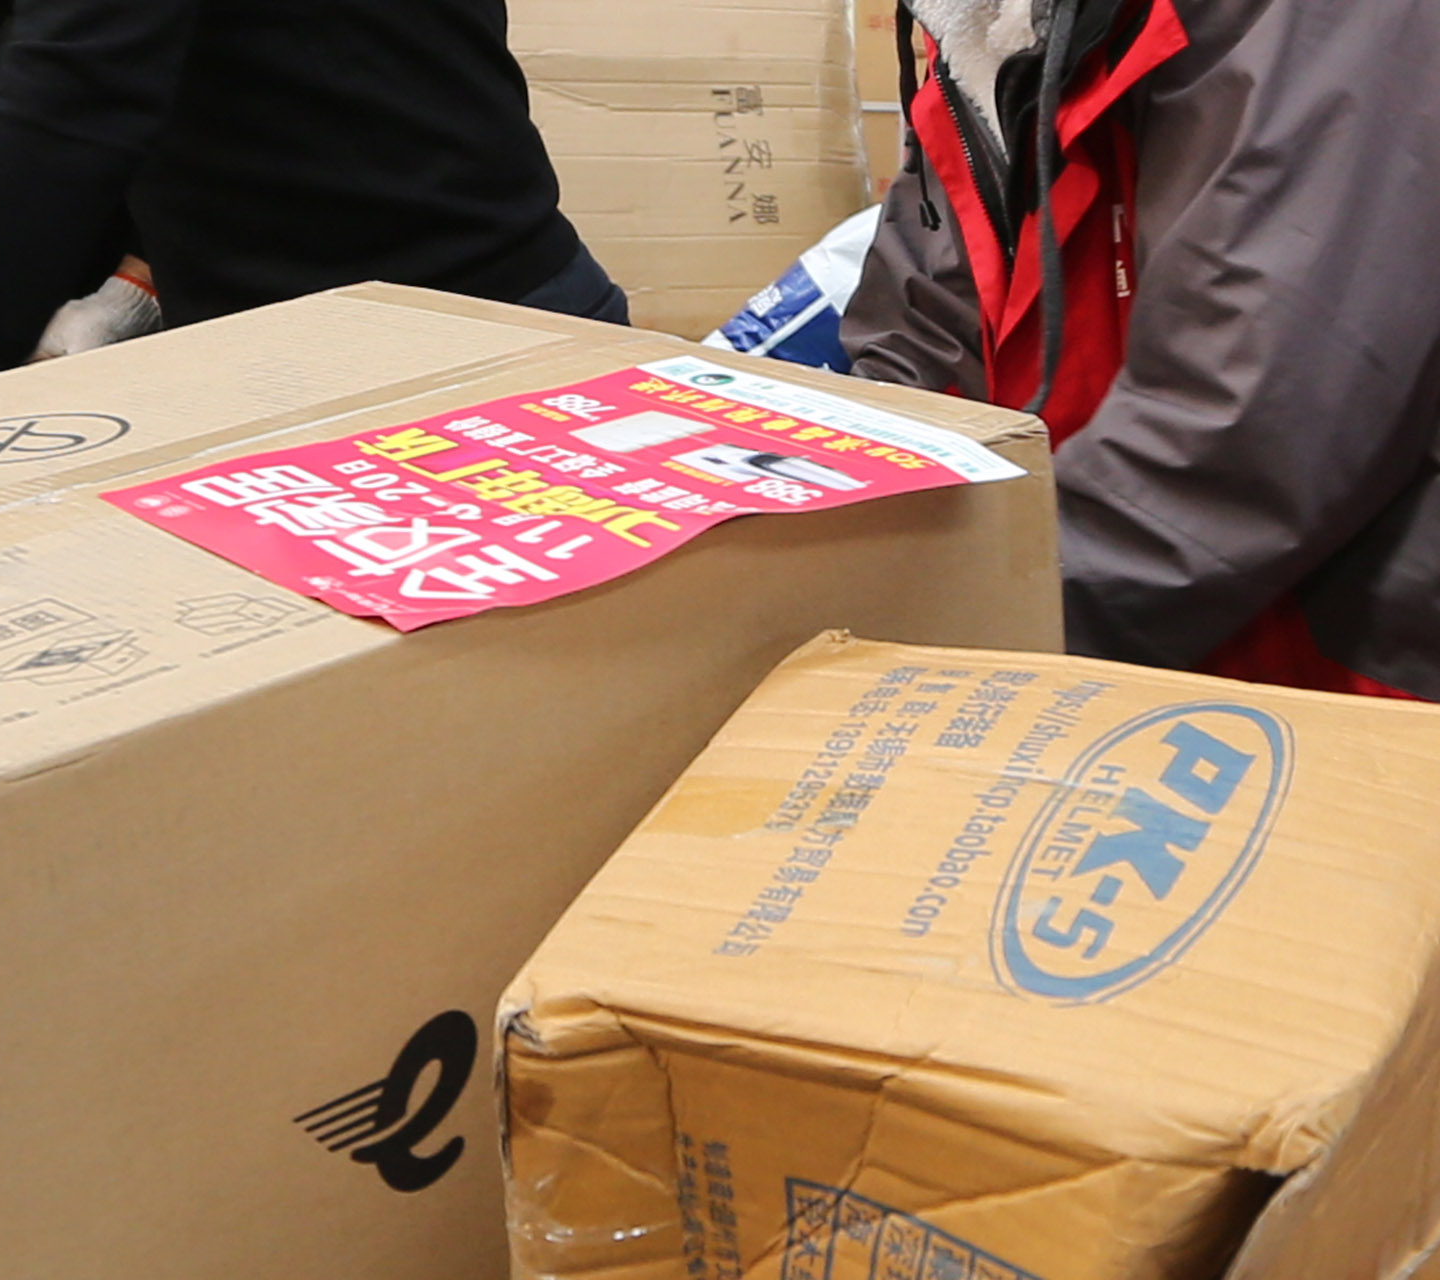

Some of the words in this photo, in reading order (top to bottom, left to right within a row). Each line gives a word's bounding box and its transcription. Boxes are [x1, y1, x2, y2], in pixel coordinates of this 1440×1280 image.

[711, 89, 747, 224] FUANNA
[737, 85, 780, 225] 富安娜
[180, 464, 559, 601] 全友家居
[1031, 762, 1128, 885] HELMET
[1032, 720, 1258, 961] PK-5
